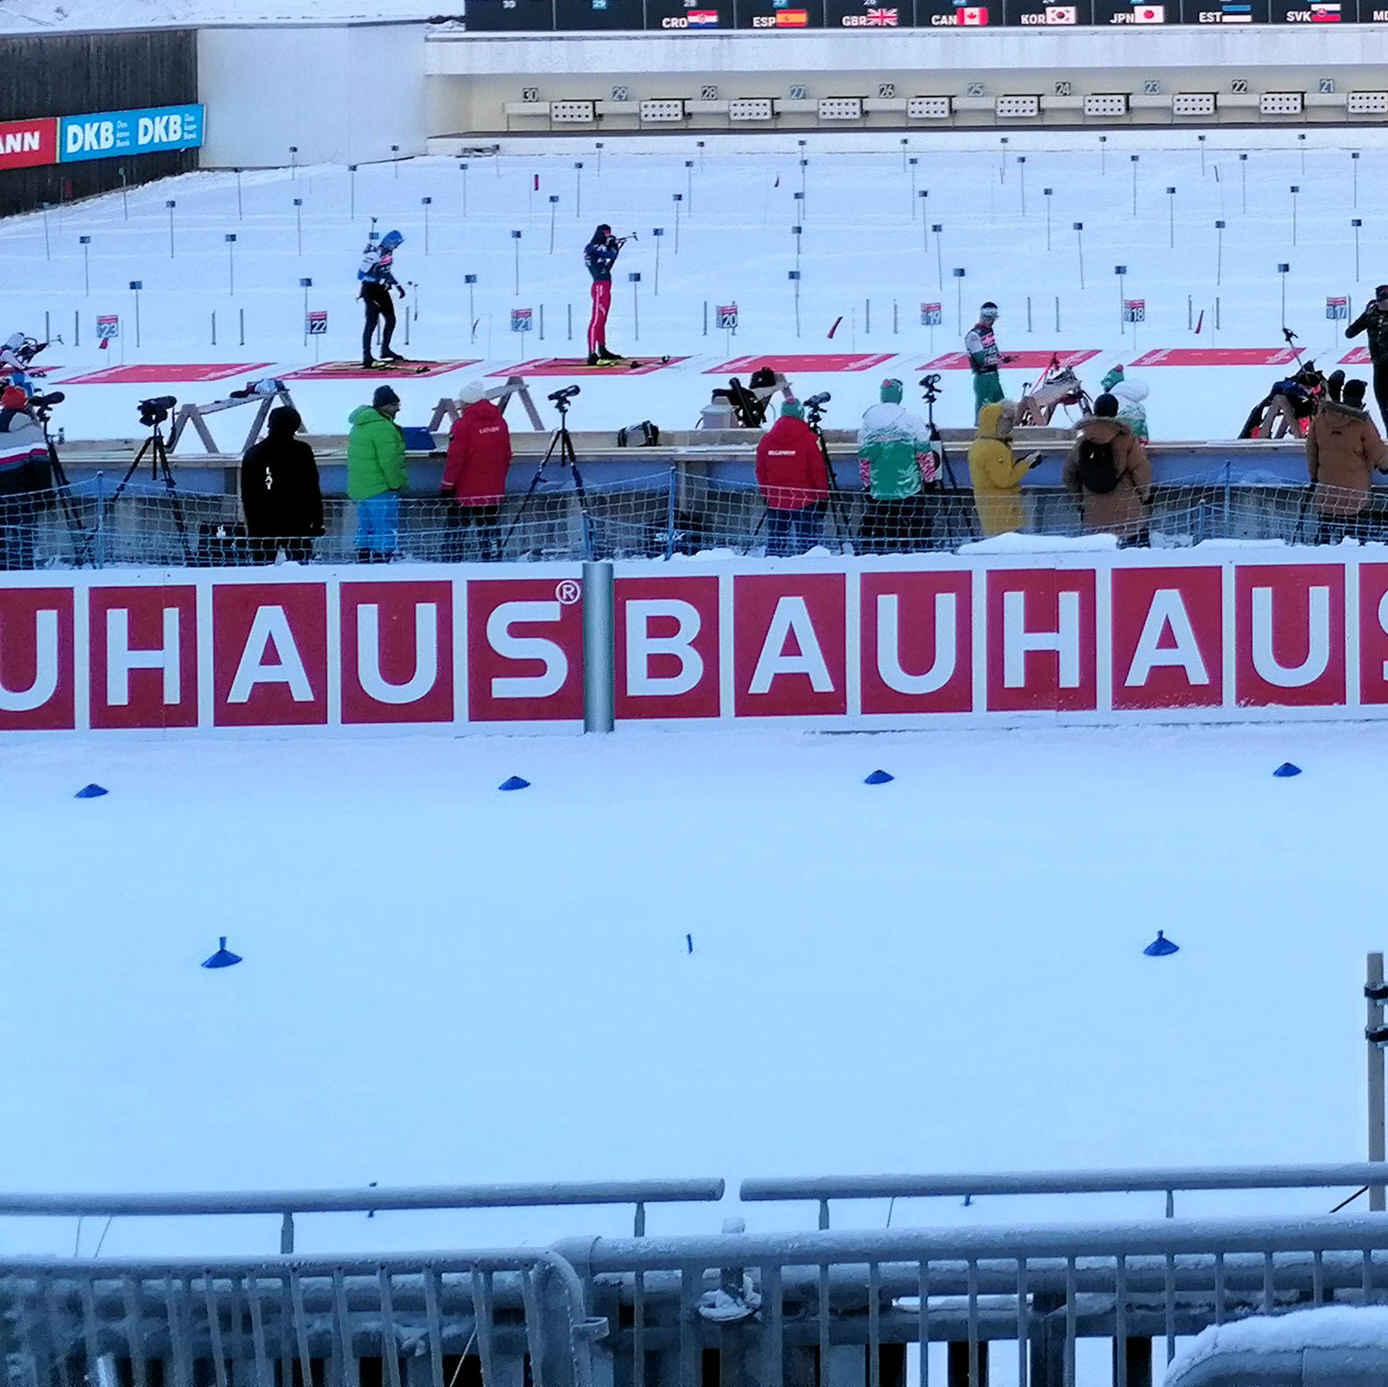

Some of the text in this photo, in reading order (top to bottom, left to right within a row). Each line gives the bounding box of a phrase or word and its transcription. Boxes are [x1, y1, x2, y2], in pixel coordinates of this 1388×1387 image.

[662, 18, 688, 28] CRO
[753, 17, 776, 27] ESP
[842, 16, 868, 26] GBR
[932, 16, 957, 25] CAN
[1021, 15, 1046, 24] KOR
[1110, 14, 1134, 24] JPN
[1199, 13, 1222, 22] EST
[1286, 12, 1311, 21] SVK
[879, 85, 894, 98] 26
[968, 83, 983, 96] 25
[1056, 82, 1070, 95] 24
[1145, 81, 1159, 95] 23
[1232, 80, 1246, 93] 22
[1321, 79, 1334, 92] 21
[523, 88, 537, 101] 30
[612, 87, 627, 101] 29
[701, 86, 717, 100] 28
[790, 86, 805, 99] 27
[138, 114, 182, 145] DKB
[66, 120, 114, 153] DKB
[929, 312, 940, 324] 19
[1134, 309, 1144, 321] 18
[1337, 306, 1346, 318] 17
[312, 321, 327, 333] 22
[518, 318, 529, 330] 21
[723, 314, 737, 327] 20
[100, 323, 118, 337] 23
